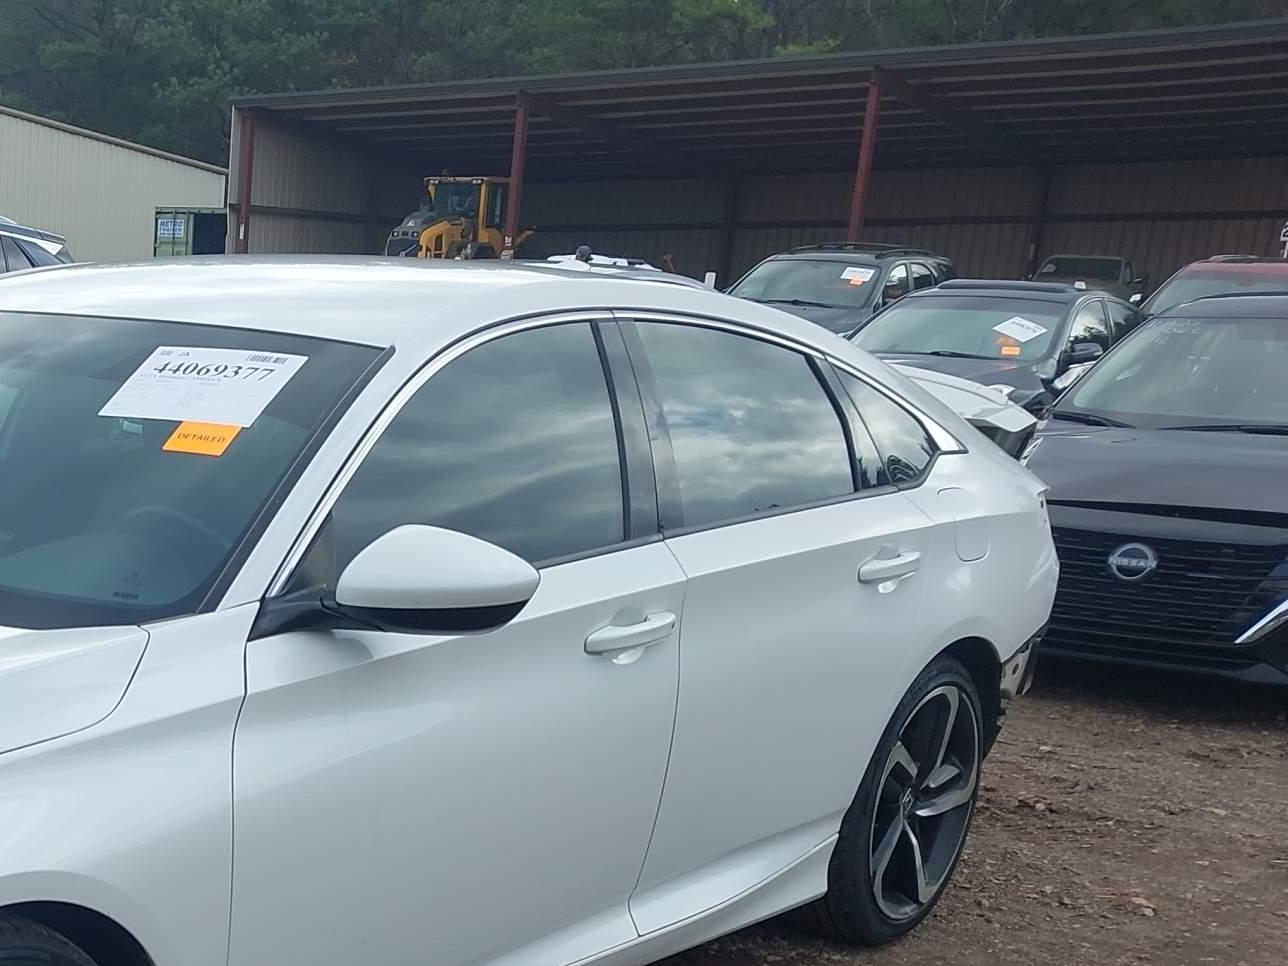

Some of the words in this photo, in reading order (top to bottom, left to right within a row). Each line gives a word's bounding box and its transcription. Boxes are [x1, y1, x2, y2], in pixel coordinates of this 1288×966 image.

[153, 359, 277, 382] 44069377
[176, 431, 226, 444] DETAILED
[1109, 558, 1157, 568] NISSAN
